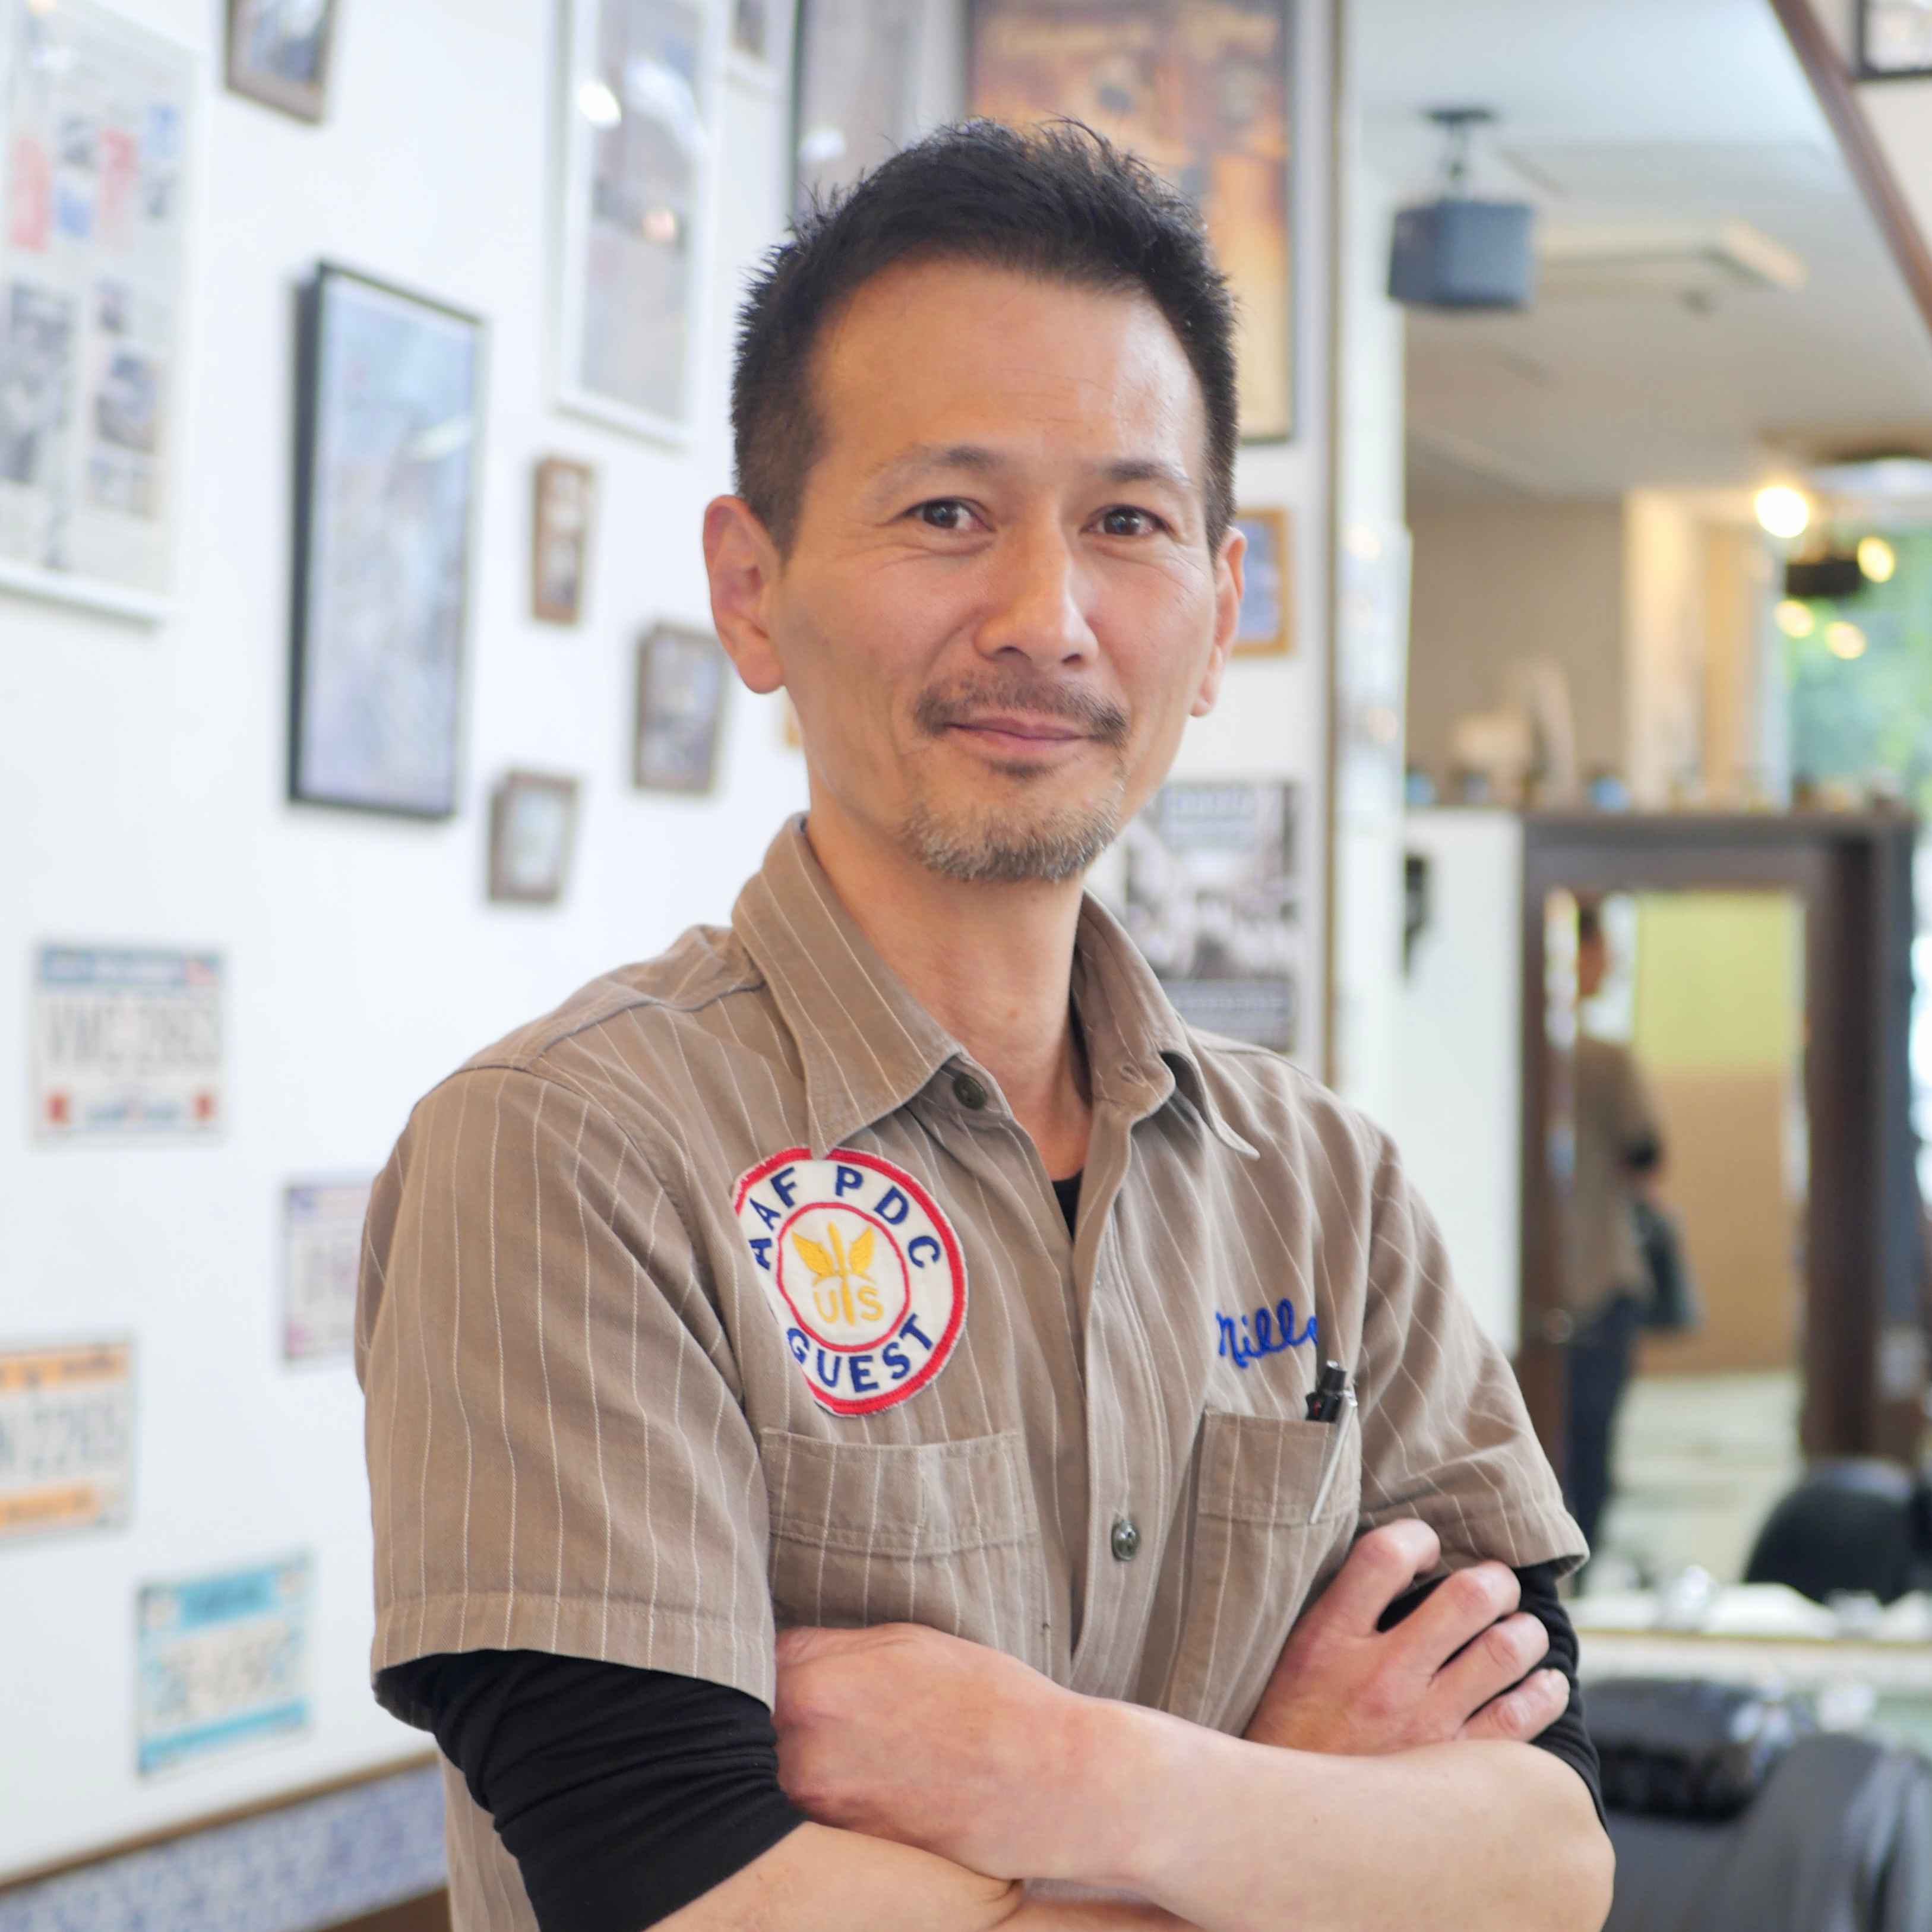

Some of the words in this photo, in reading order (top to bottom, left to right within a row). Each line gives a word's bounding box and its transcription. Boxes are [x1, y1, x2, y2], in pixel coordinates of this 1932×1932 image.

[748, 1166, 798, 1270] AAF
[834, 1165, 941, 1269] PDC
[786, 1313, 934, 1393] GUEST
